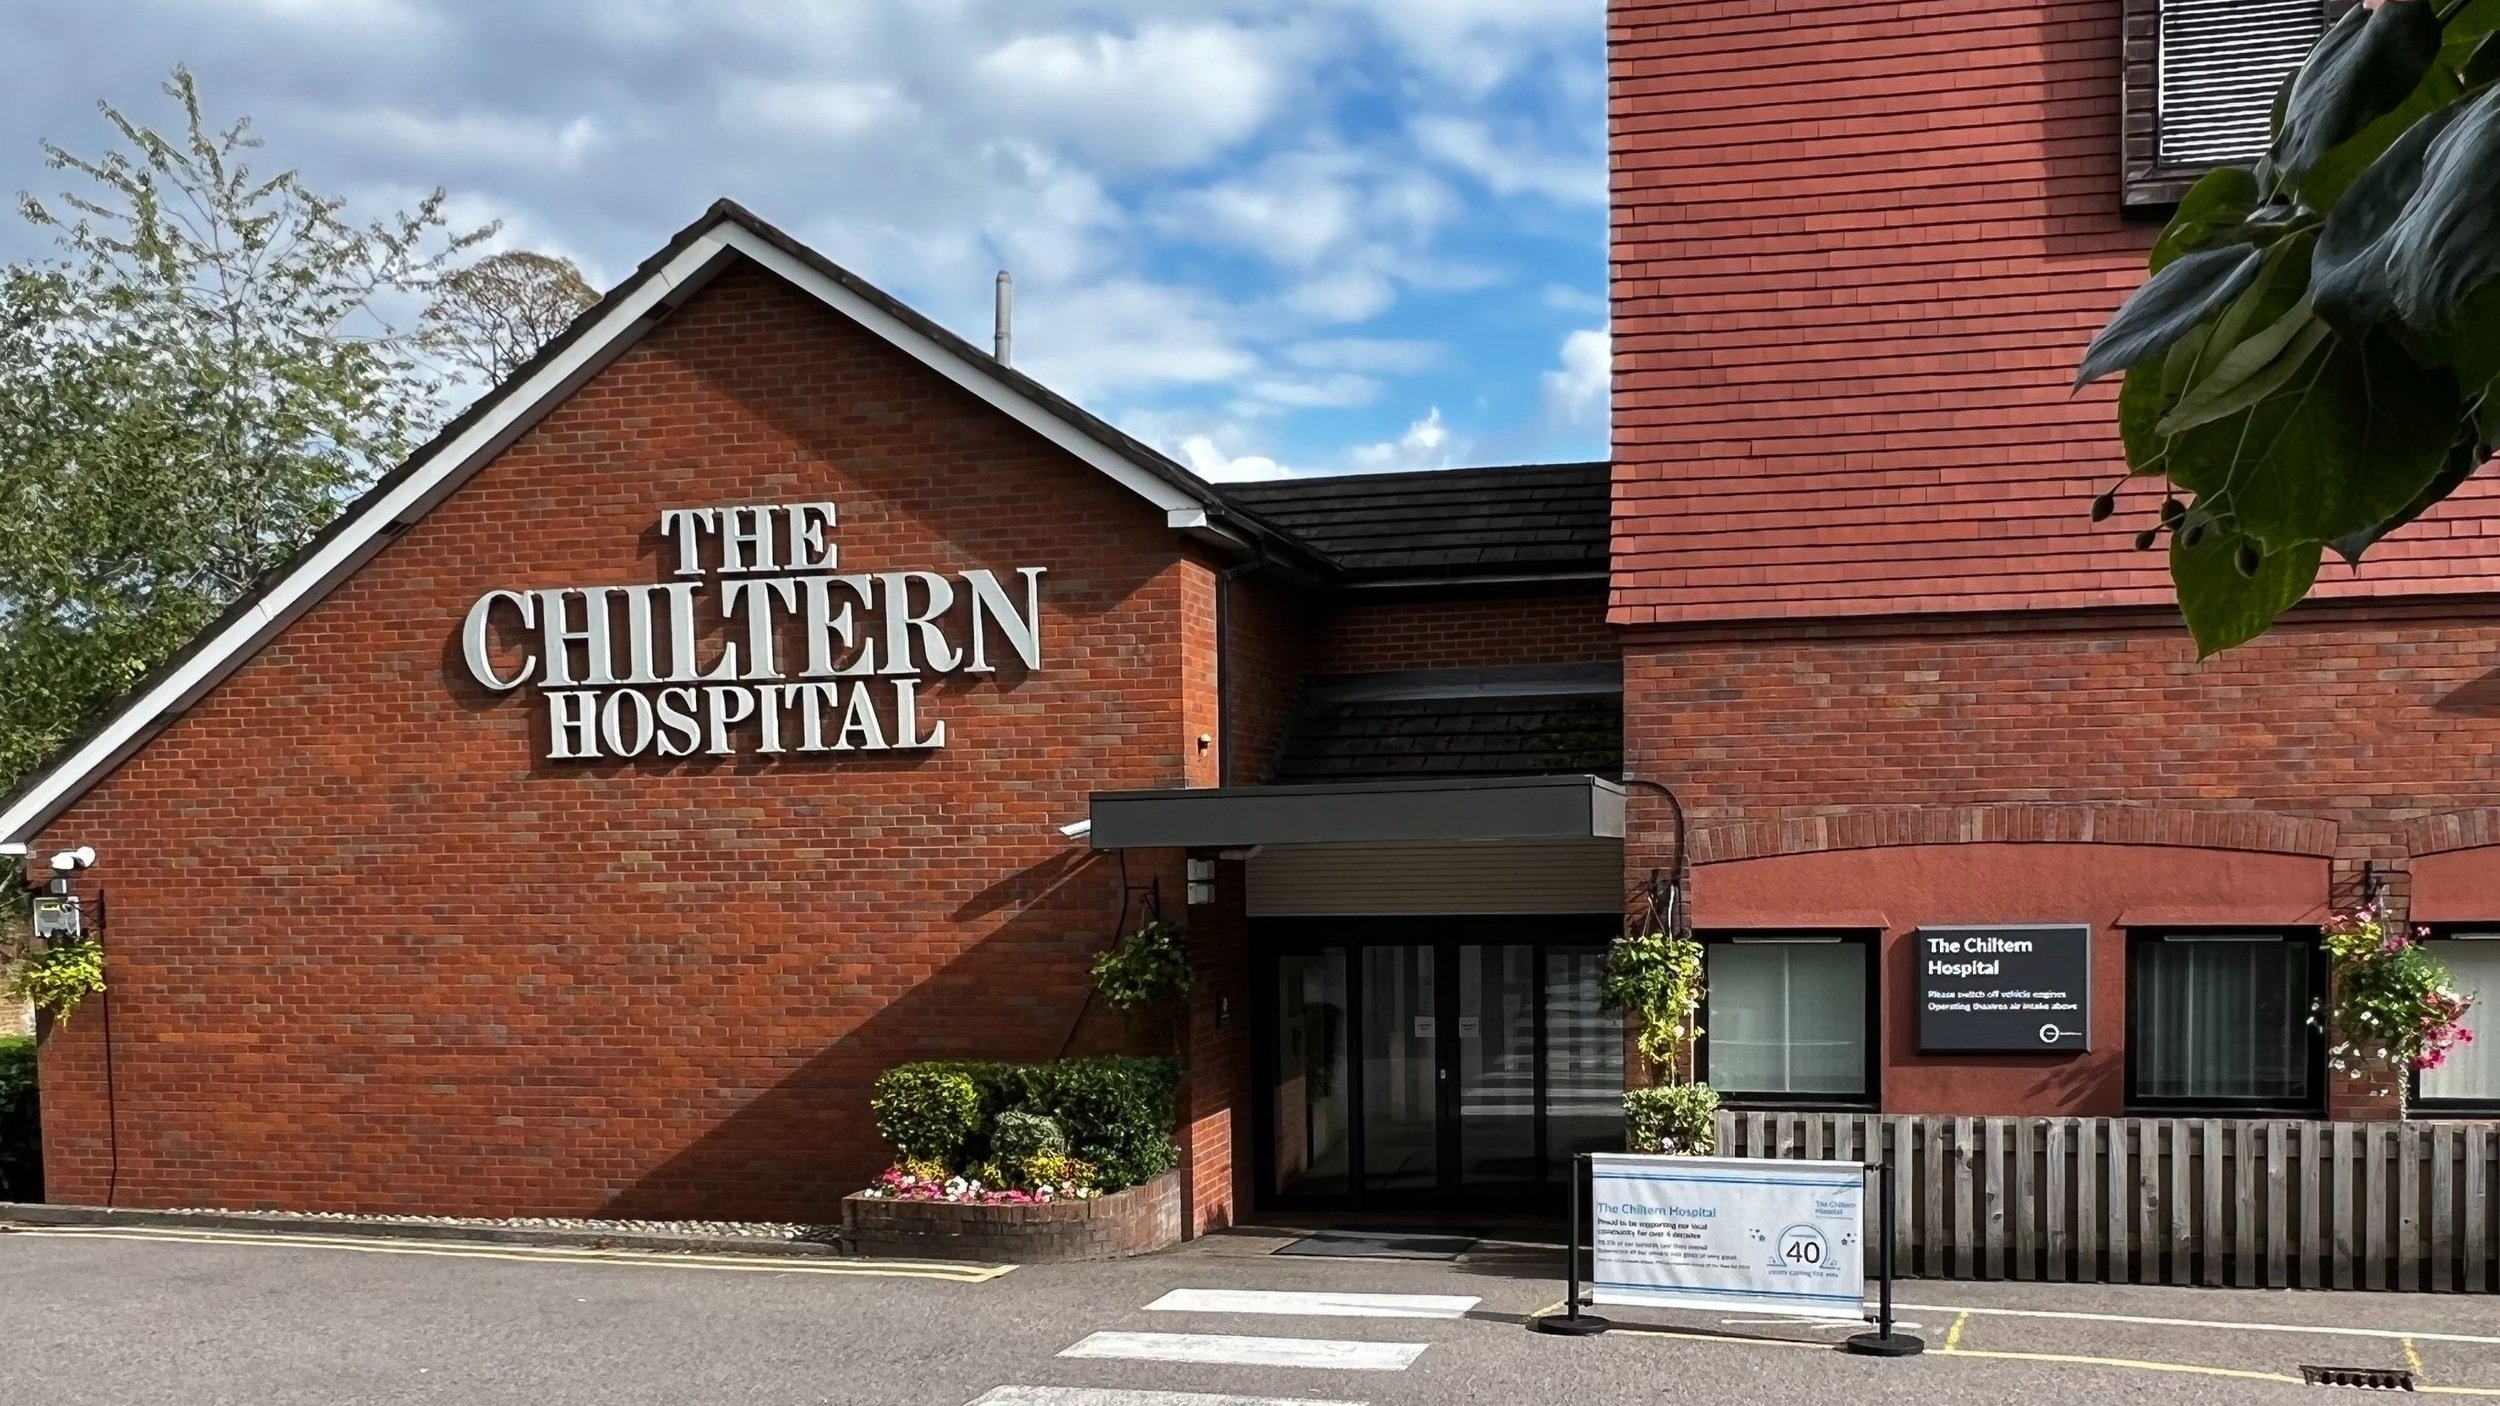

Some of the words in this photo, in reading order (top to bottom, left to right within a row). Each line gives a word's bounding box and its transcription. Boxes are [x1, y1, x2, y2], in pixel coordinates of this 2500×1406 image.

[661, 501, 838, 575] THE
[462, 566, 1048, 691] CHILTERN
[543, 678, 945, 760] HOSPITAL
[1927, 938, 1960, 953] The
[1964, 937, 2033, 953] Chiltern
[1928, 960, 1999, 978] Hospital
[1928, 990, 1955, 998] Please
[1957, 990, 1986, 998] switch
[1987, 990, 2000, 998] off
[2001, 990, 2031, 998] vehicle
[2033, 990, 2066, 999] engines
[1928, 1003, 1971, 1011] Operating
[1598, 1202, 1619, 1214] The
[1621, 1204, 1666, 1216] Chiltern
[1669, 1206, 1716, 1218] Hospital
[1597, 1218, 1618, 1226] Proud
[1639, 1221, 1676, 1229] supporting
[1786, 1241, 1820, 1264] 40
